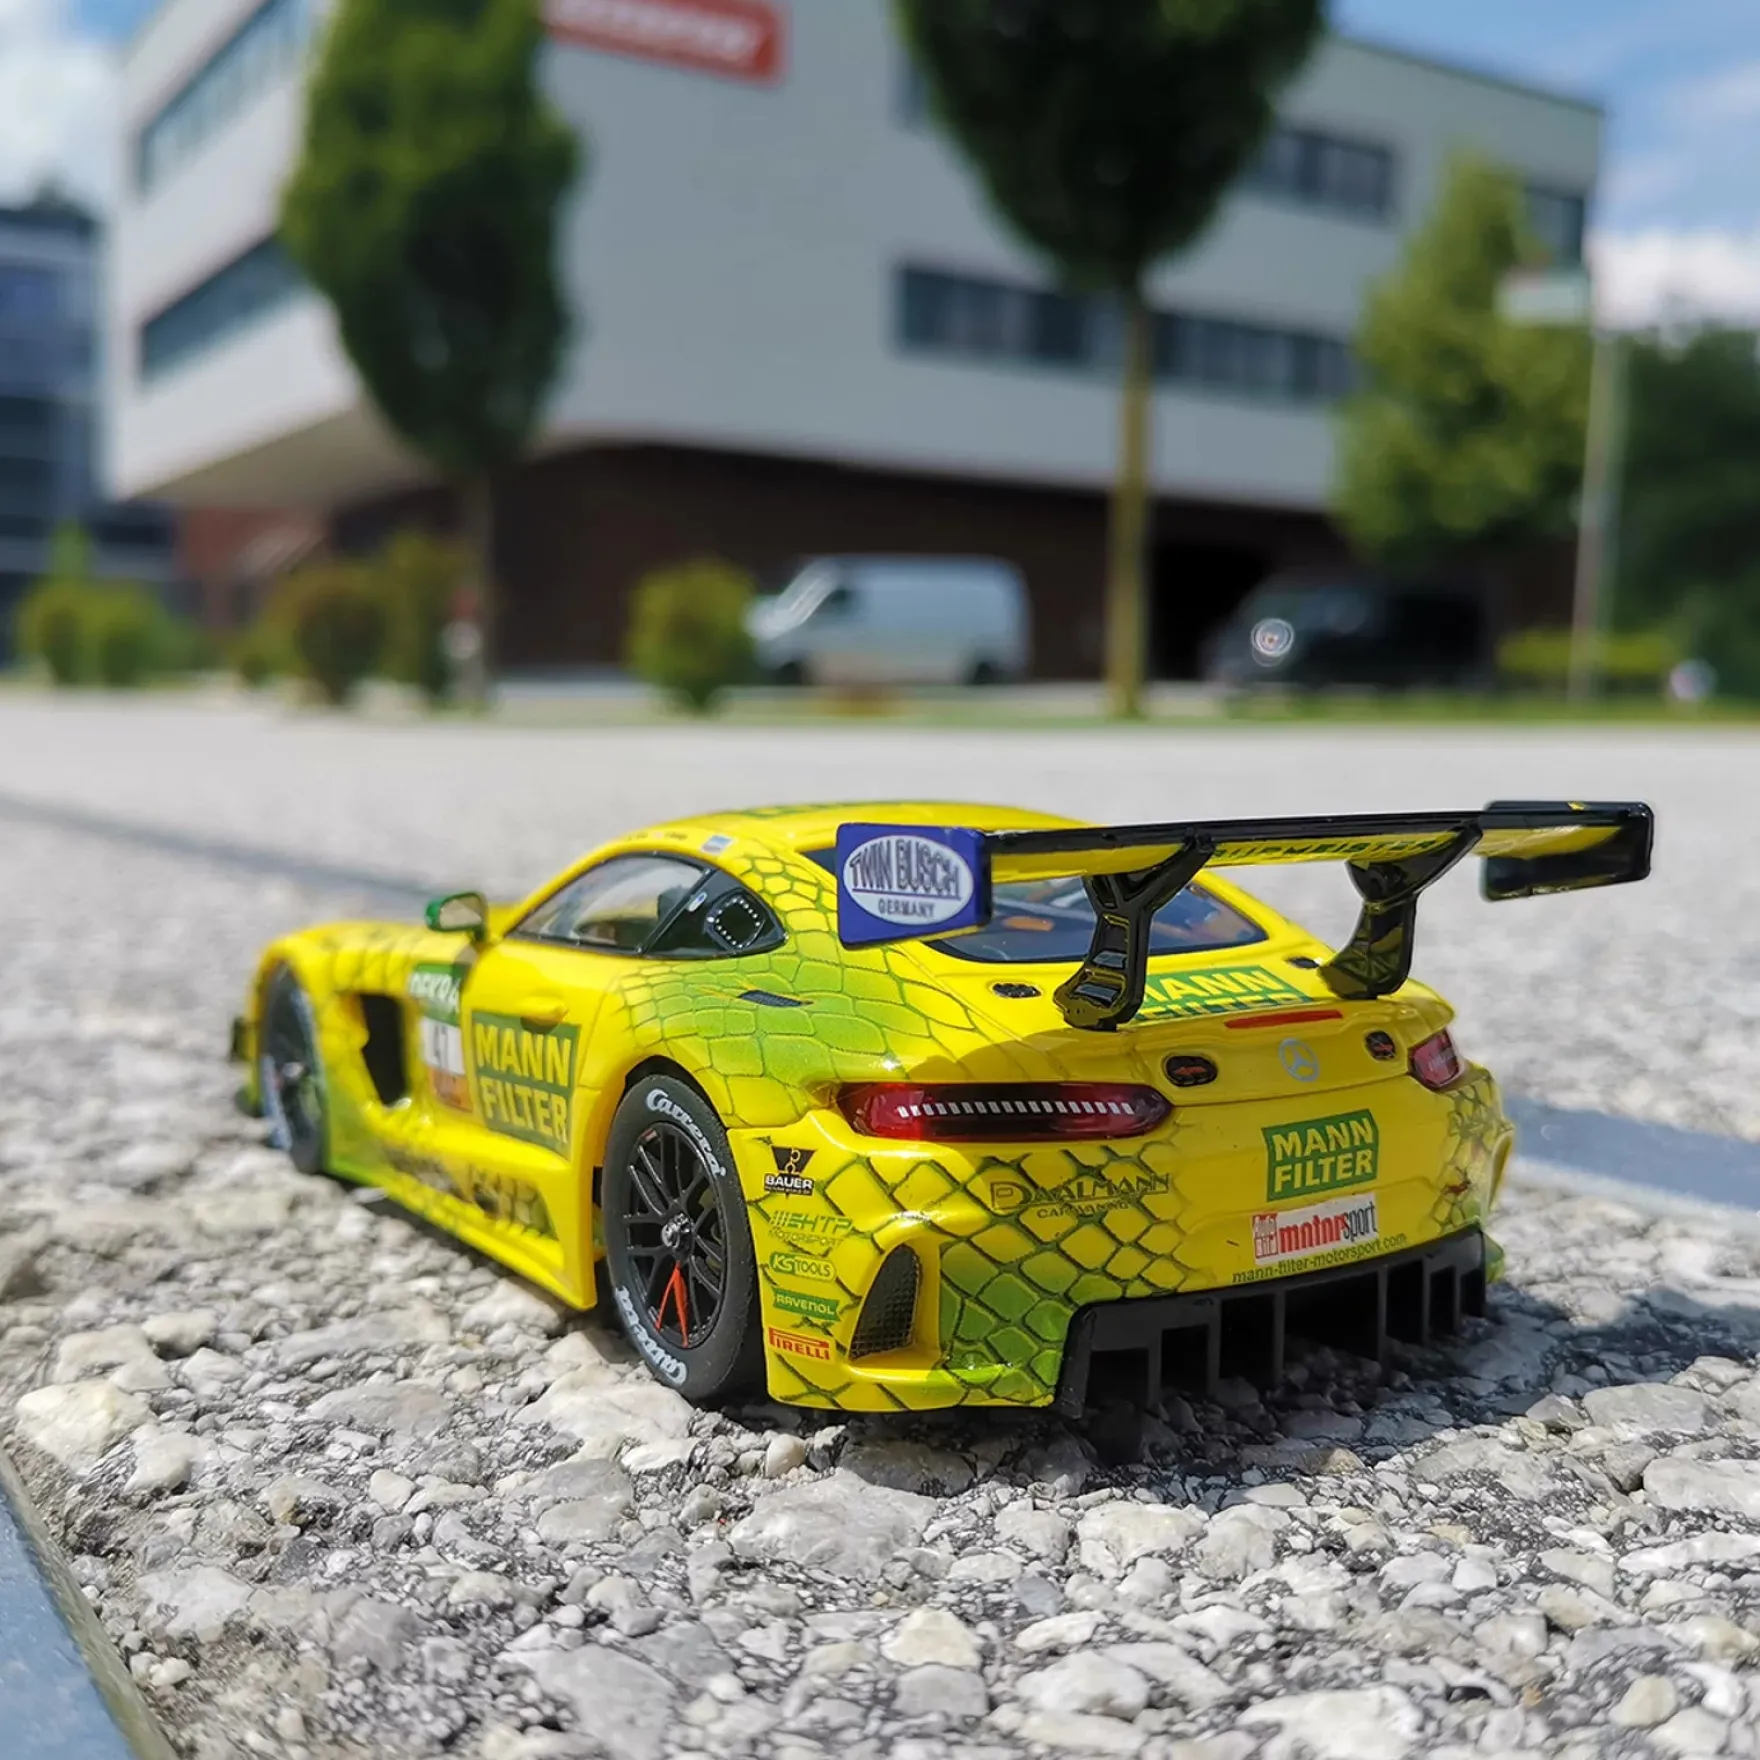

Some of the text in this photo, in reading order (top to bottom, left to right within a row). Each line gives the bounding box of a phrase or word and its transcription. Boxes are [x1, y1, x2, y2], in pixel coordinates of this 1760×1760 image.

[849, 839, 960, 897] TWIN BUSCH
[878, 899, 936, 917] GERMANY
[475, 1022, 572, 1087] MANN
[479, 1075, 568, 1144] FILTER
[645, 1088, 727, 1178] Carrera
[1271, 1117, 1374, 1161] MANN
[765, 1174, 813, 1190] BAUER
[1274, 1149, 1374, 1192] FILTER
[1279, 1200, 1379, 1253] motorsport
[1232, 1232, 1408, 1283] mann-filter-motorsport.com
[776, 1293, 836, 1316] RAVENOL
[768, 1326, 831, 1361] PIRELLI
